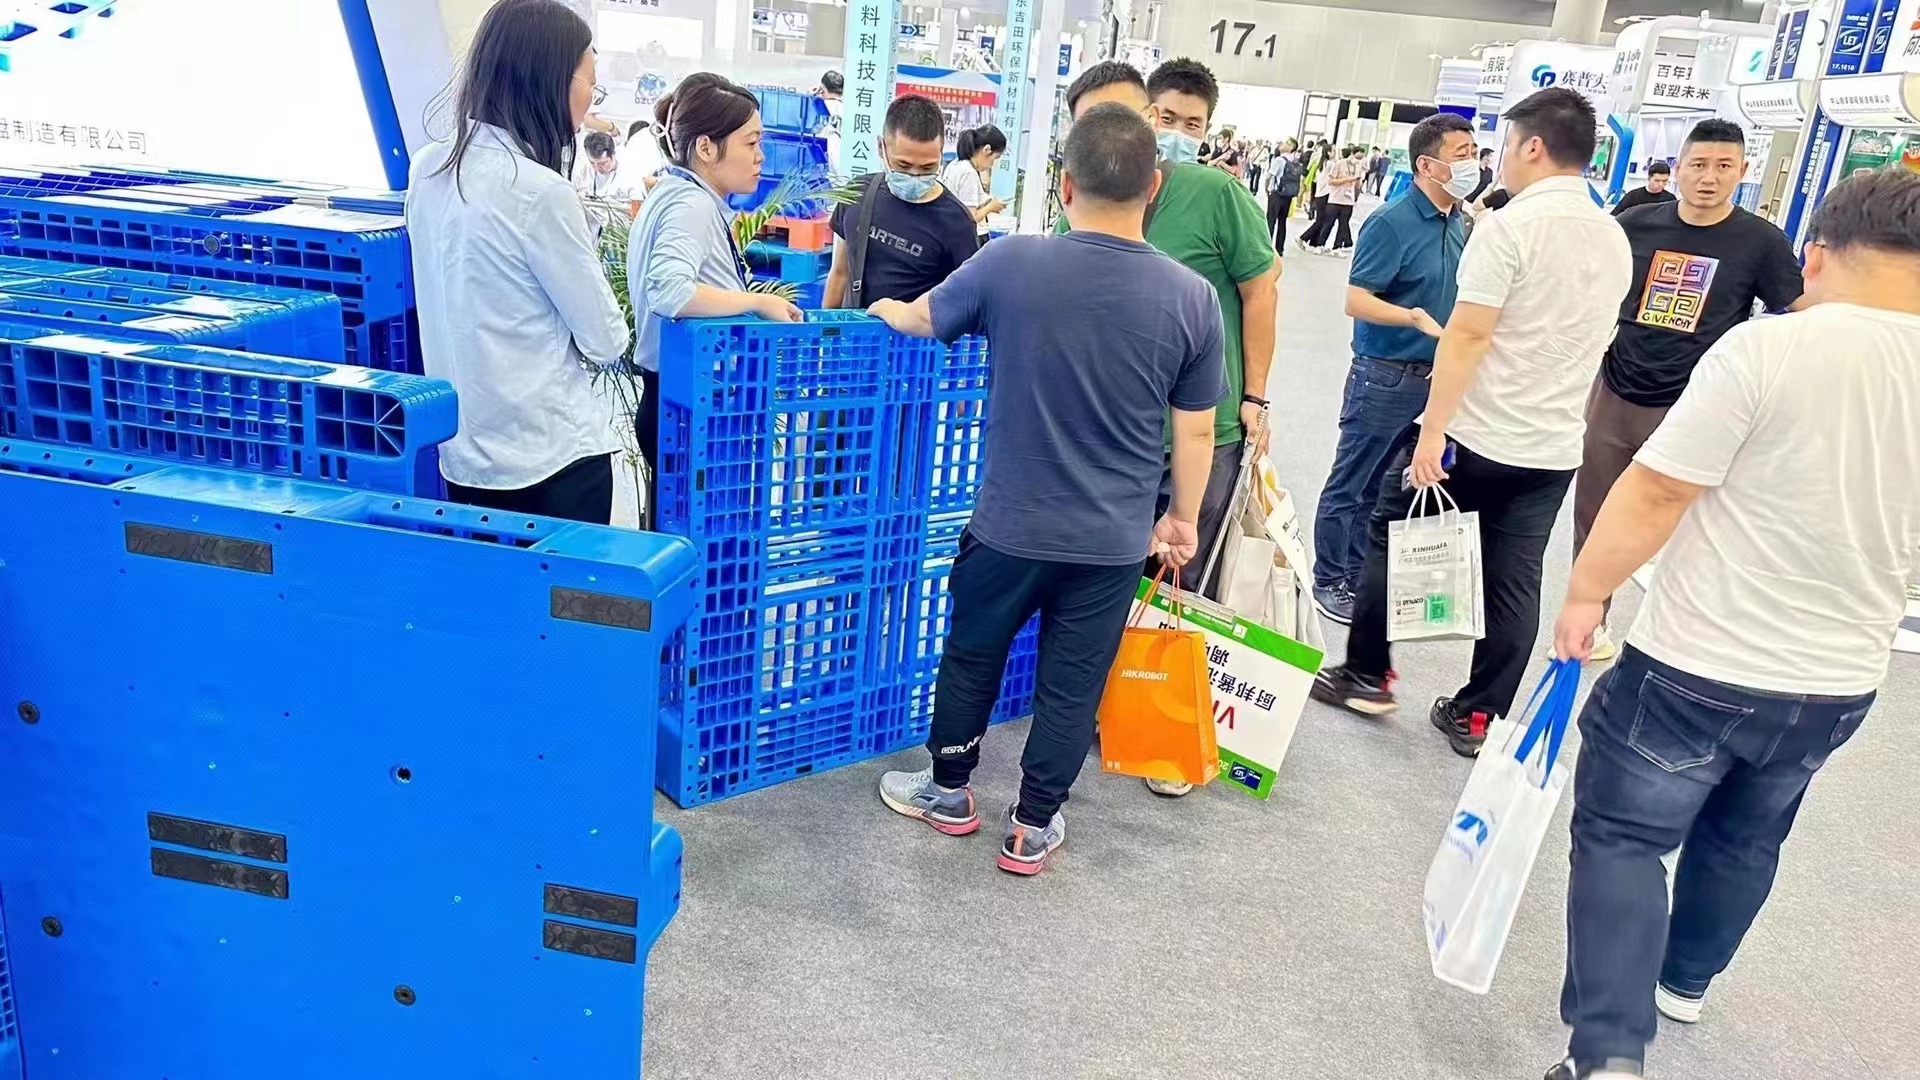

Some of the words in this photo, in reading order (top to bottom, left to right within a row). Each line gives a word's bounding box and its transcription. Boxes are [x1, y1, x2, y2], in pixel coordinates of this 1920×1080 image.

[1210, 19, 1276, 58] 17.1
[1642, 312, 1693, 330] GIVENCHY
[1121, 669, 1169, 681] HIKROBOT
